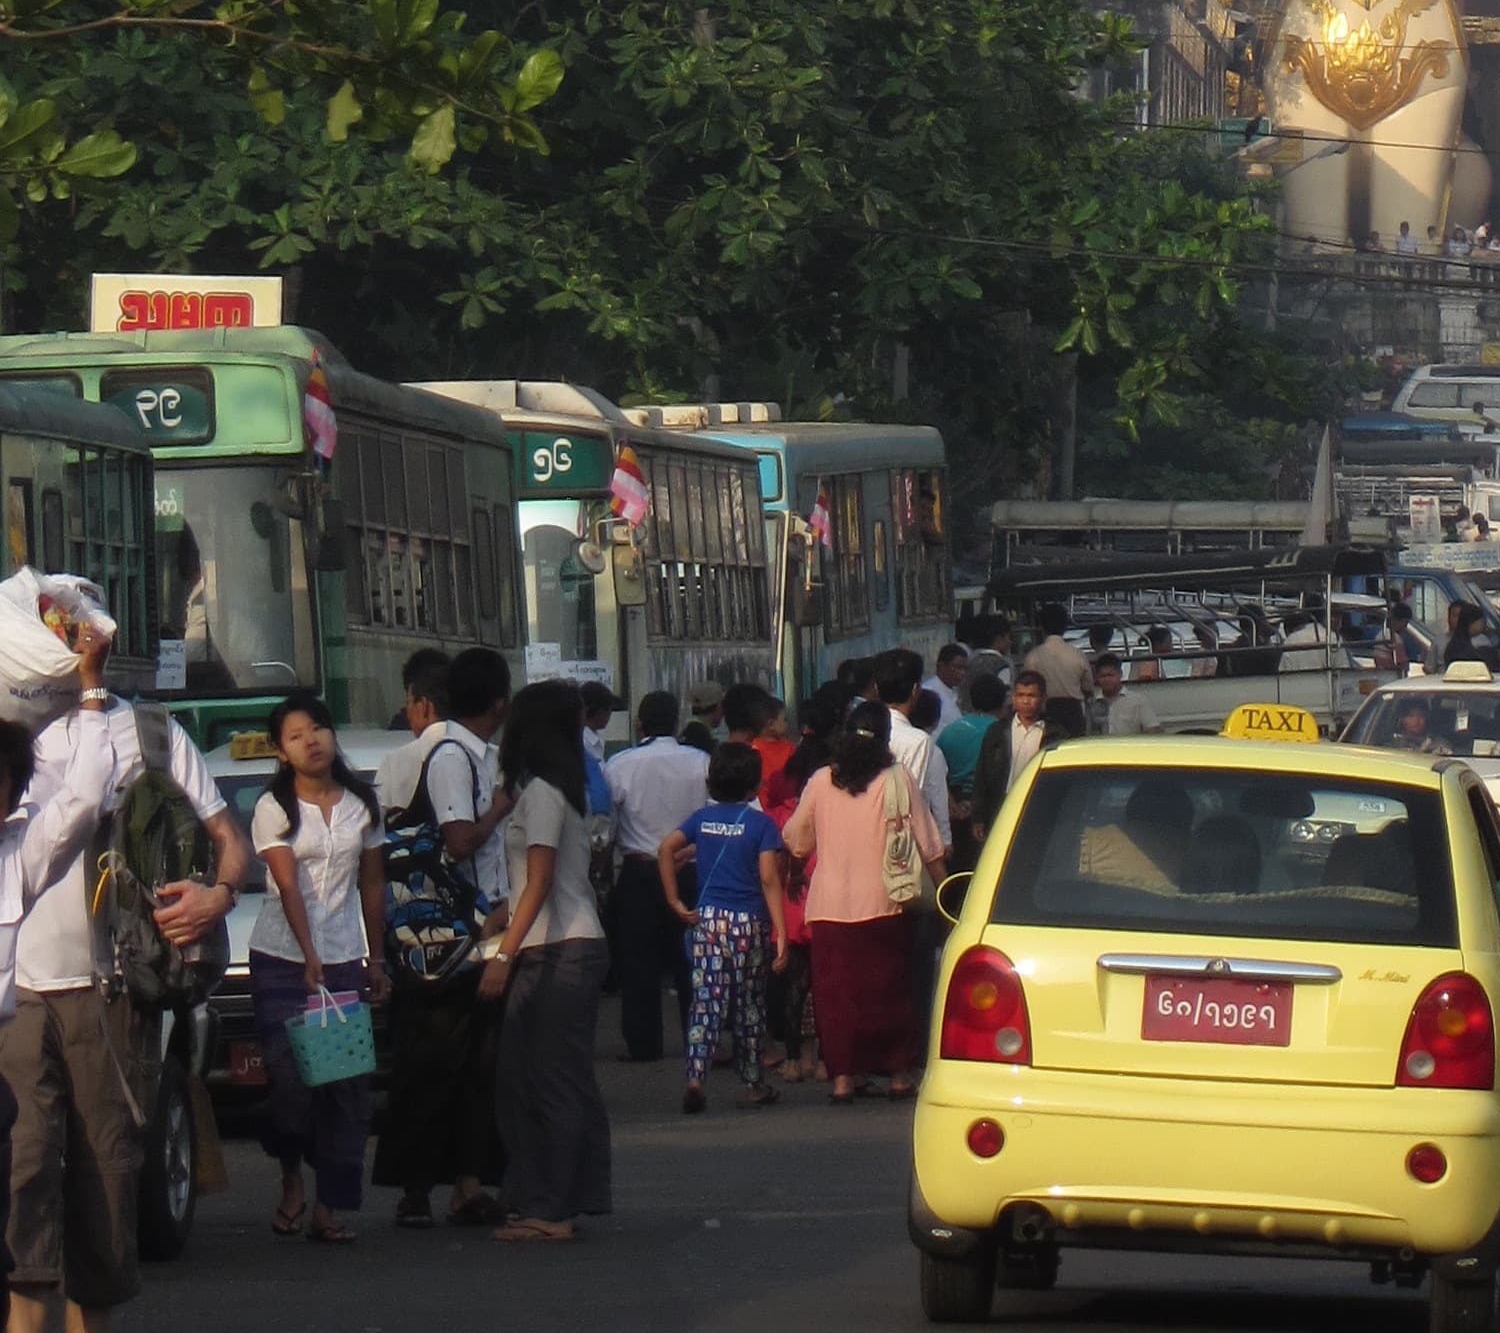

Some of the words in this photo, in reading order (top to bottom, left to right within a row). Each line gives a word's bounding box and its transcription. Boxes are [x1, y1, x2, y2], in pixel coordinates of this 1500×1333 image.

[135, 388, 182, 428] ၃၉
[533, 437, 573, 482] ၅၆
[1242, 708, 1306, 732] TAXI
